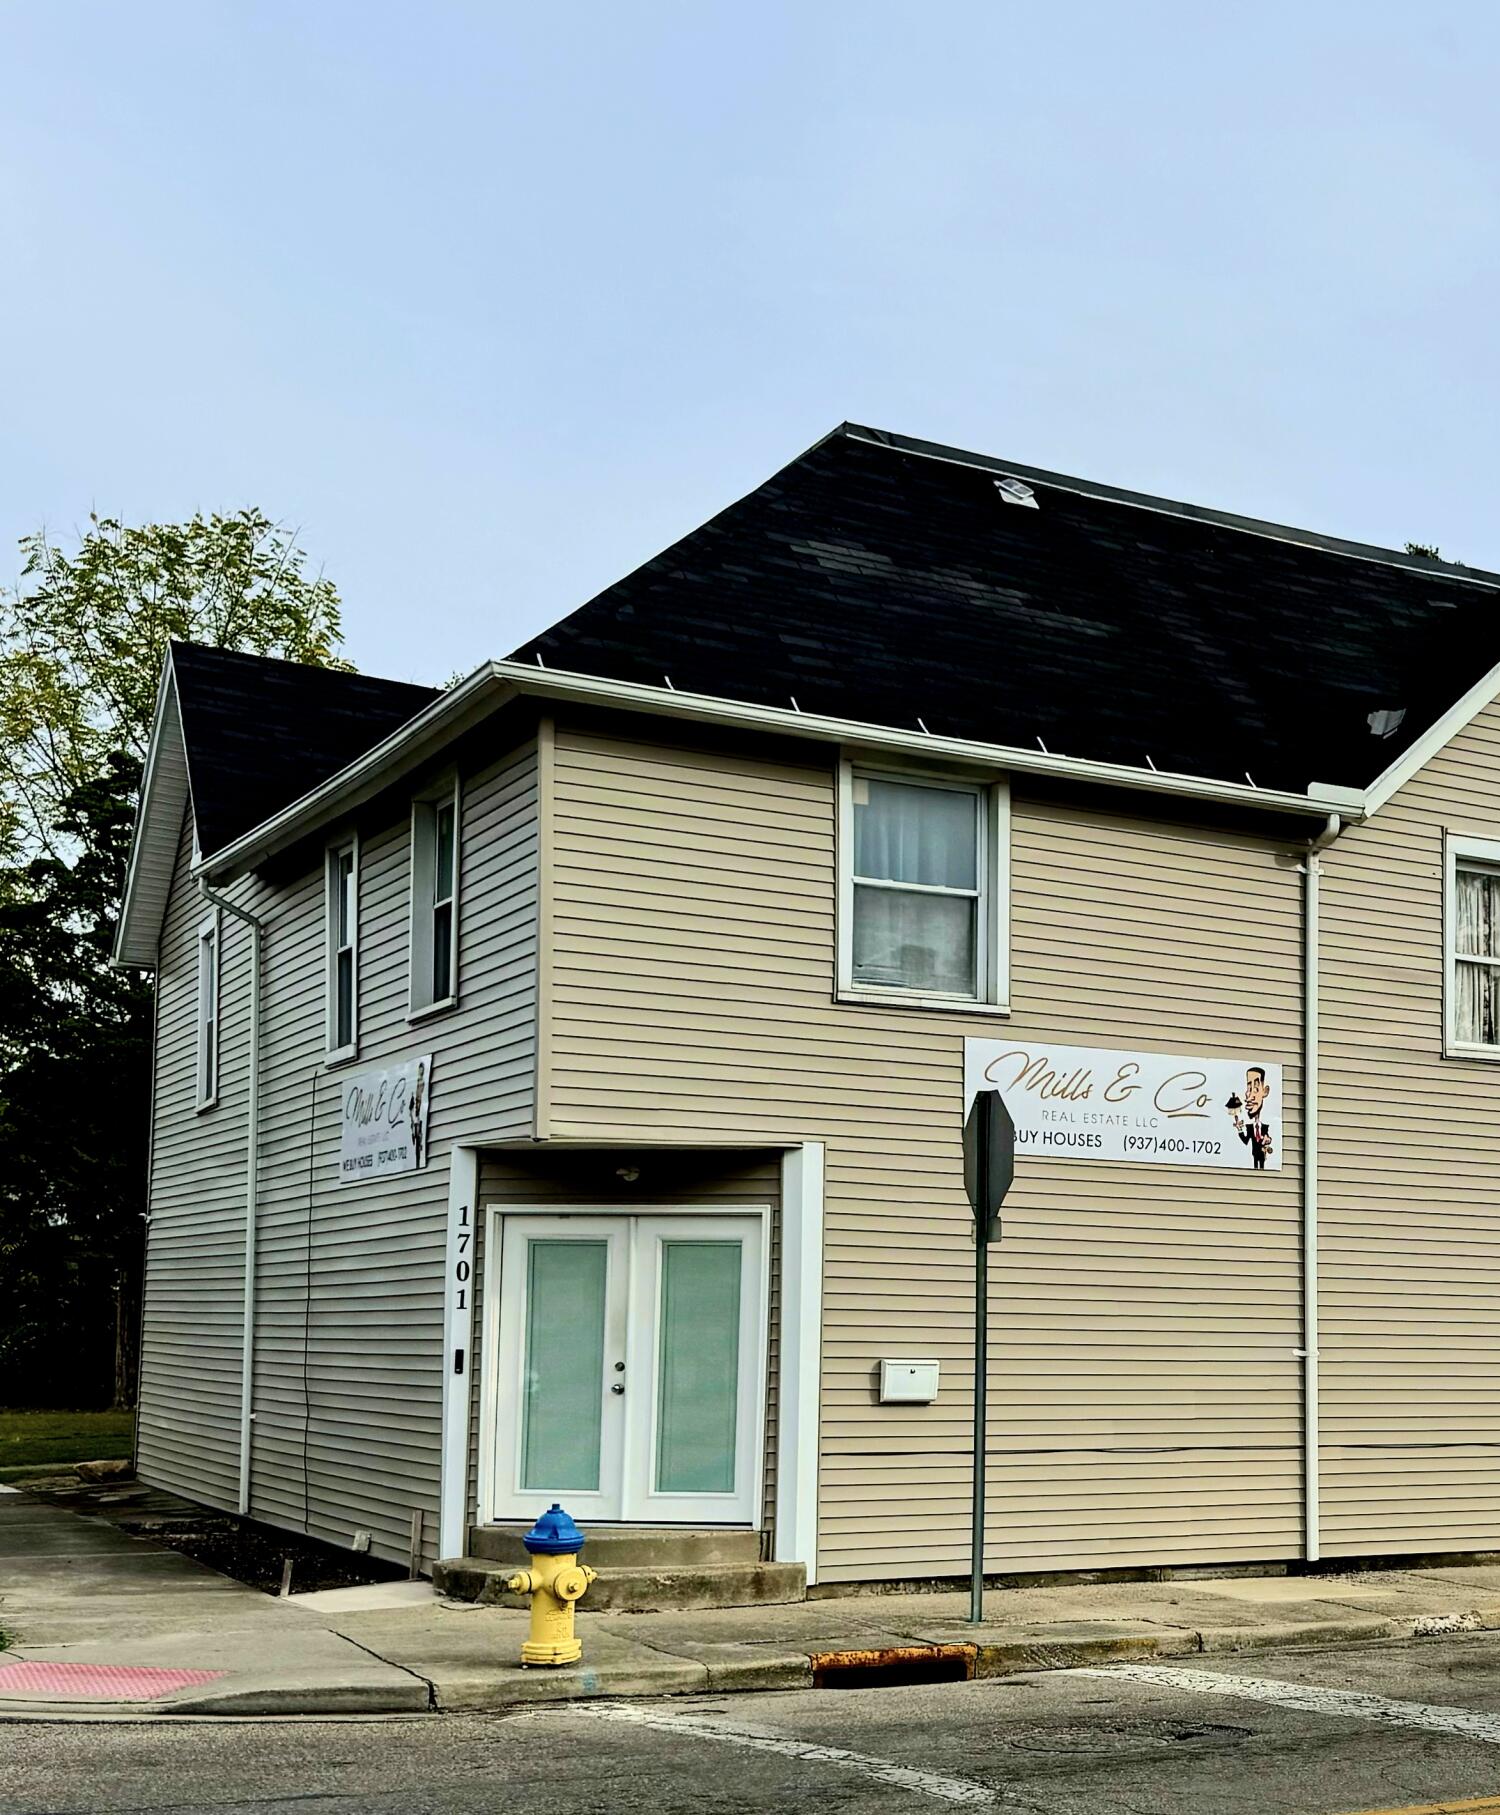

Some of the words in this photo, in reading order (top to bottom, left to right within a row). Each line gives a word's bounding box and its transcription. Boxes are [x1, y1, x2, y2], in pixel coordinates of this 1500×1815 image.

[984, 1051, 1094, 1100] Mills
[1104, 1062, 1143, 1102] &
[1154, 1071, 1212, 1113] Co
[1041, 1109, 1077, 1123] REAL
[1083, 1112, 1129, 1127] ESTATE
[1135, 1117, 1159, 1128] LLC
[1043, 1131, 1102, 1148] HOUSES
[1123, 1134, 1221, 1155] (937)400-1702
[456, 1205, 471, 1310] 1701
